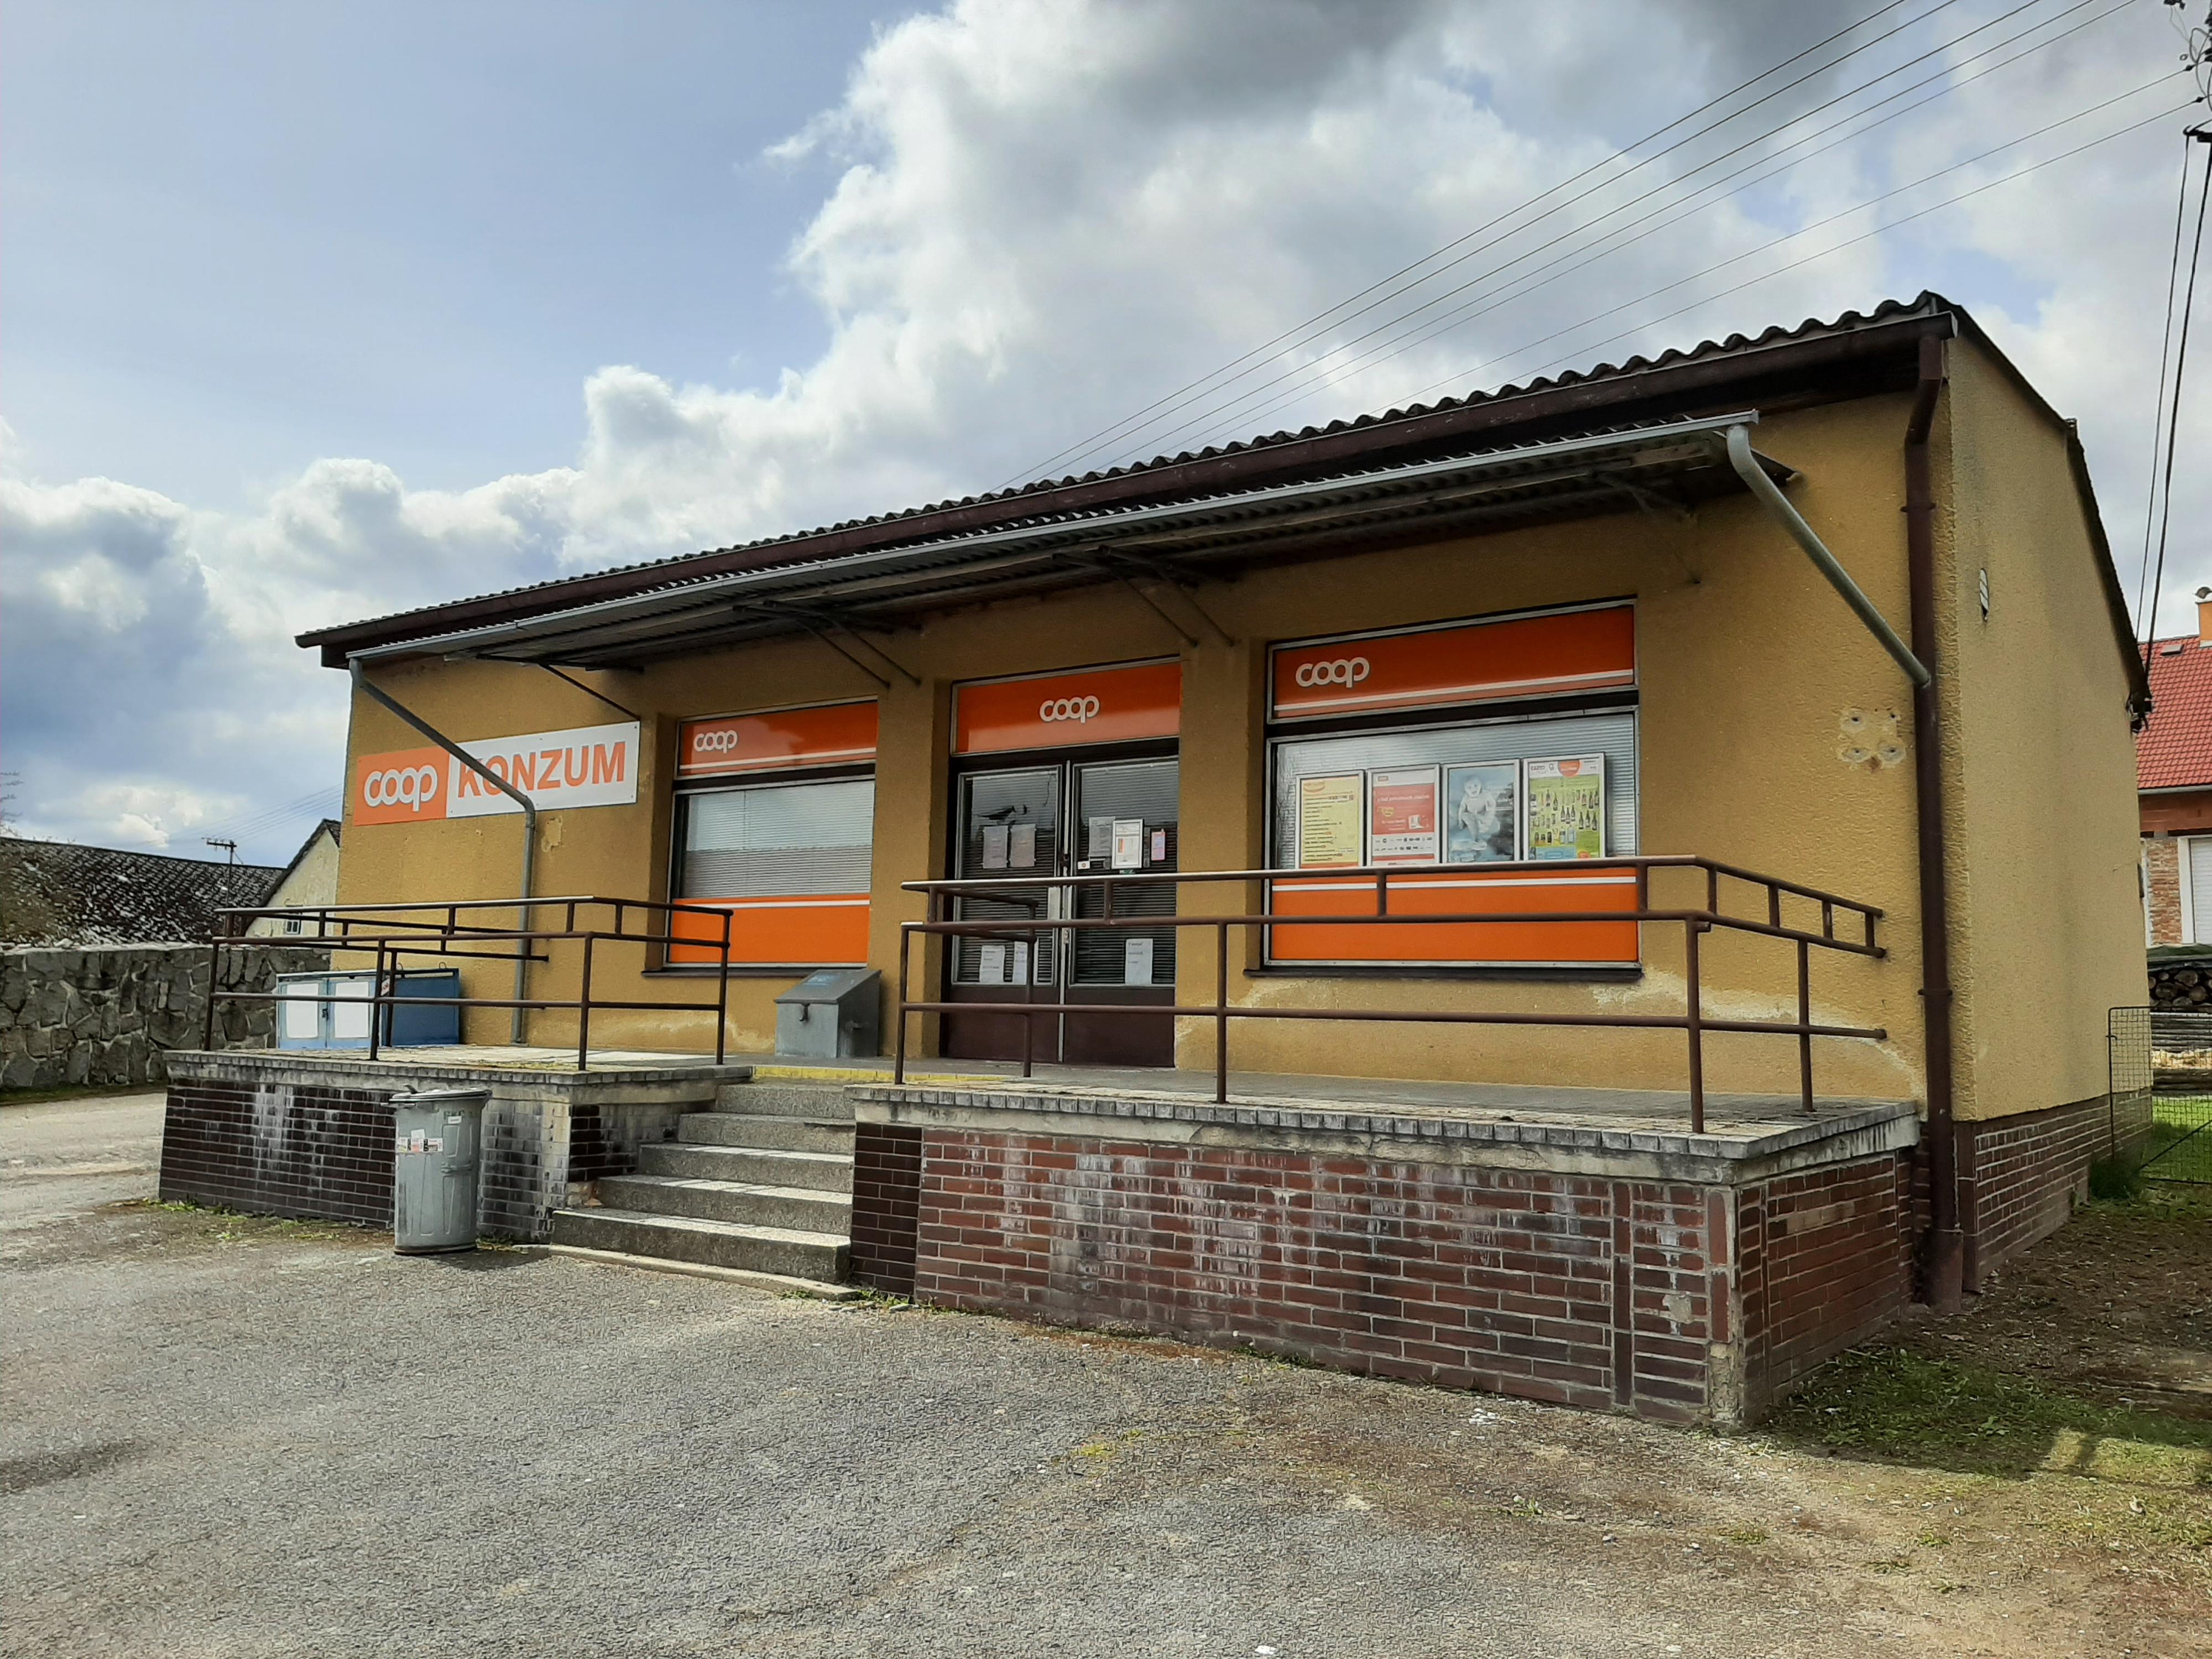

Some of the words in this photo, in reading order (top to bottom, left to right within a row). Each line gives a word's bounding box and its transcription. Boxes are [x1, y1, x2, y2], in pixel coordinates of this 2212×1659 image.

[1296, 656, 1370, 688] coop
[1039, 695, 1100, 723] coop
[693, 729, 738, 754] coop
[363, 764, 439, 812] coop
[457, 741, 626, 798] KONZUM
